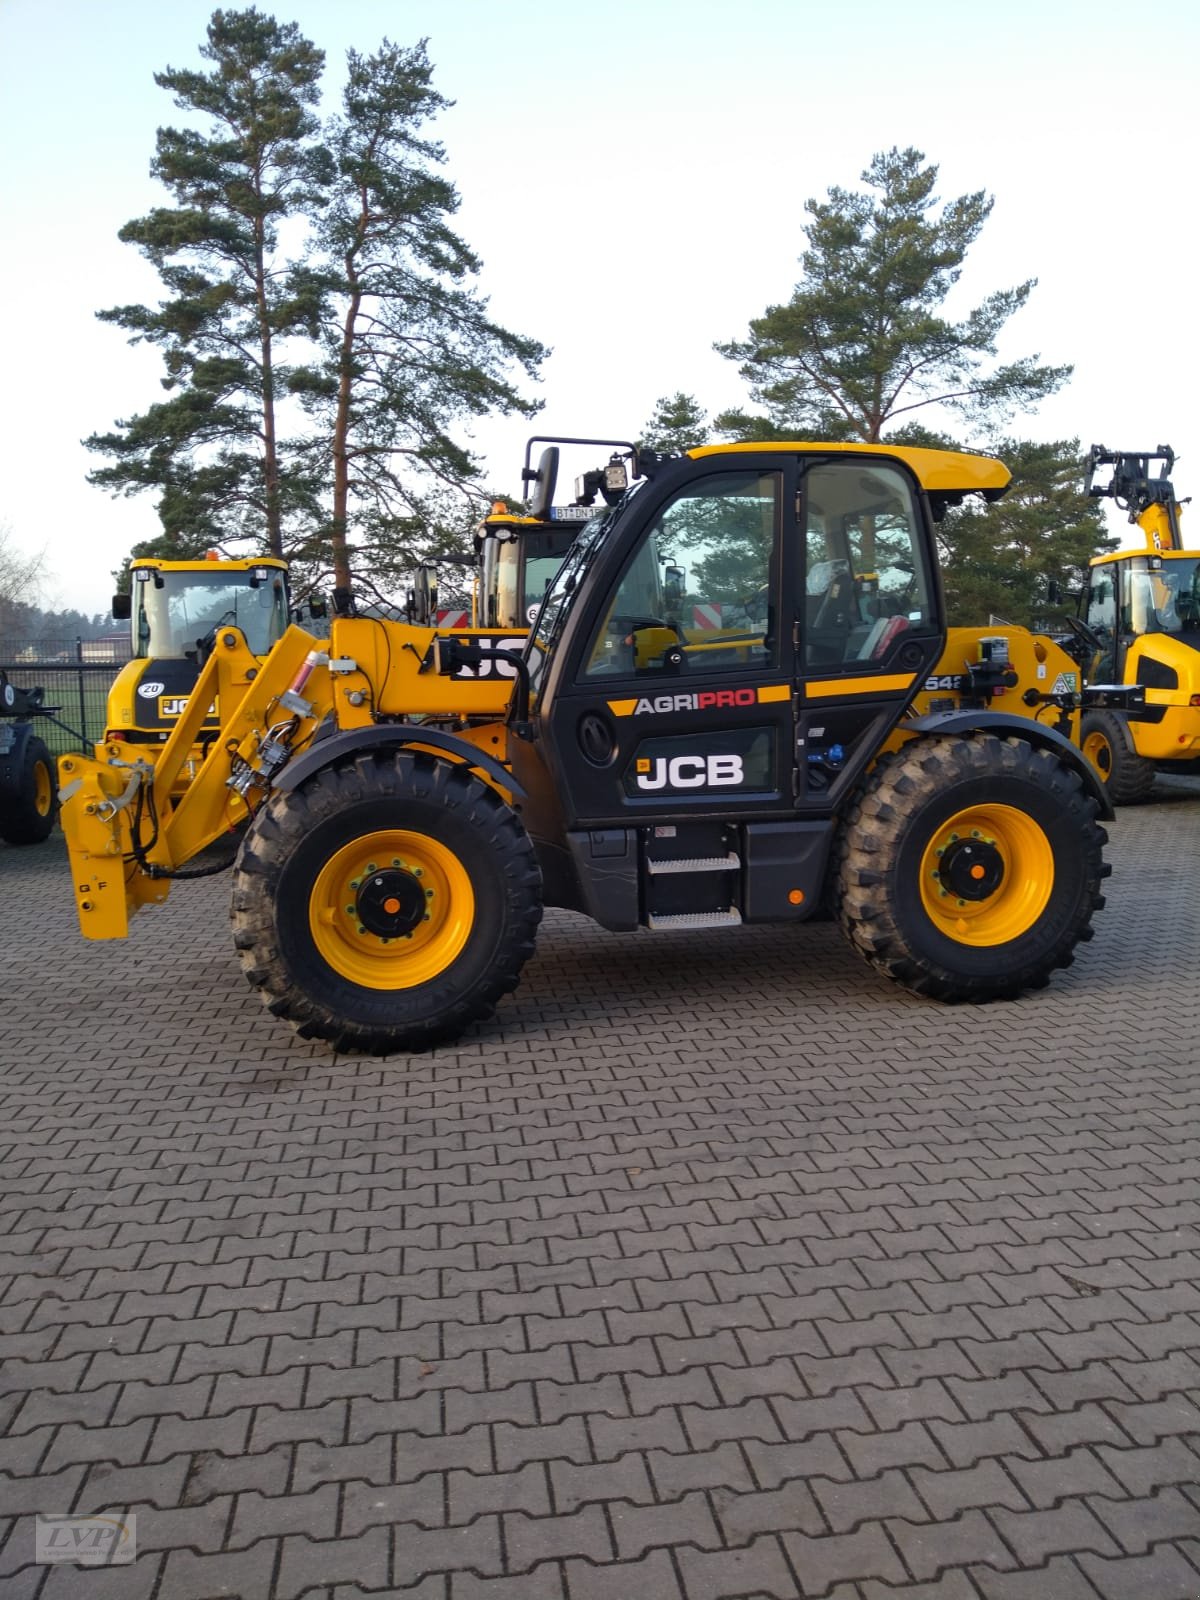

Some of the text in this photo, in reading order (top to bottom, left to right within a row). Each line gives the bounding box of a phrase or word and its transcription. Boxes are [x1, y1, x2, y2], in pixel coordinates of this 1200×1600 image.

[456, 638, 528, 677] JC
[143, 684, 160, 694] 20
[634, 688, 756, 716] AGRIPRO
[637, 754, 744, 790] JCB
